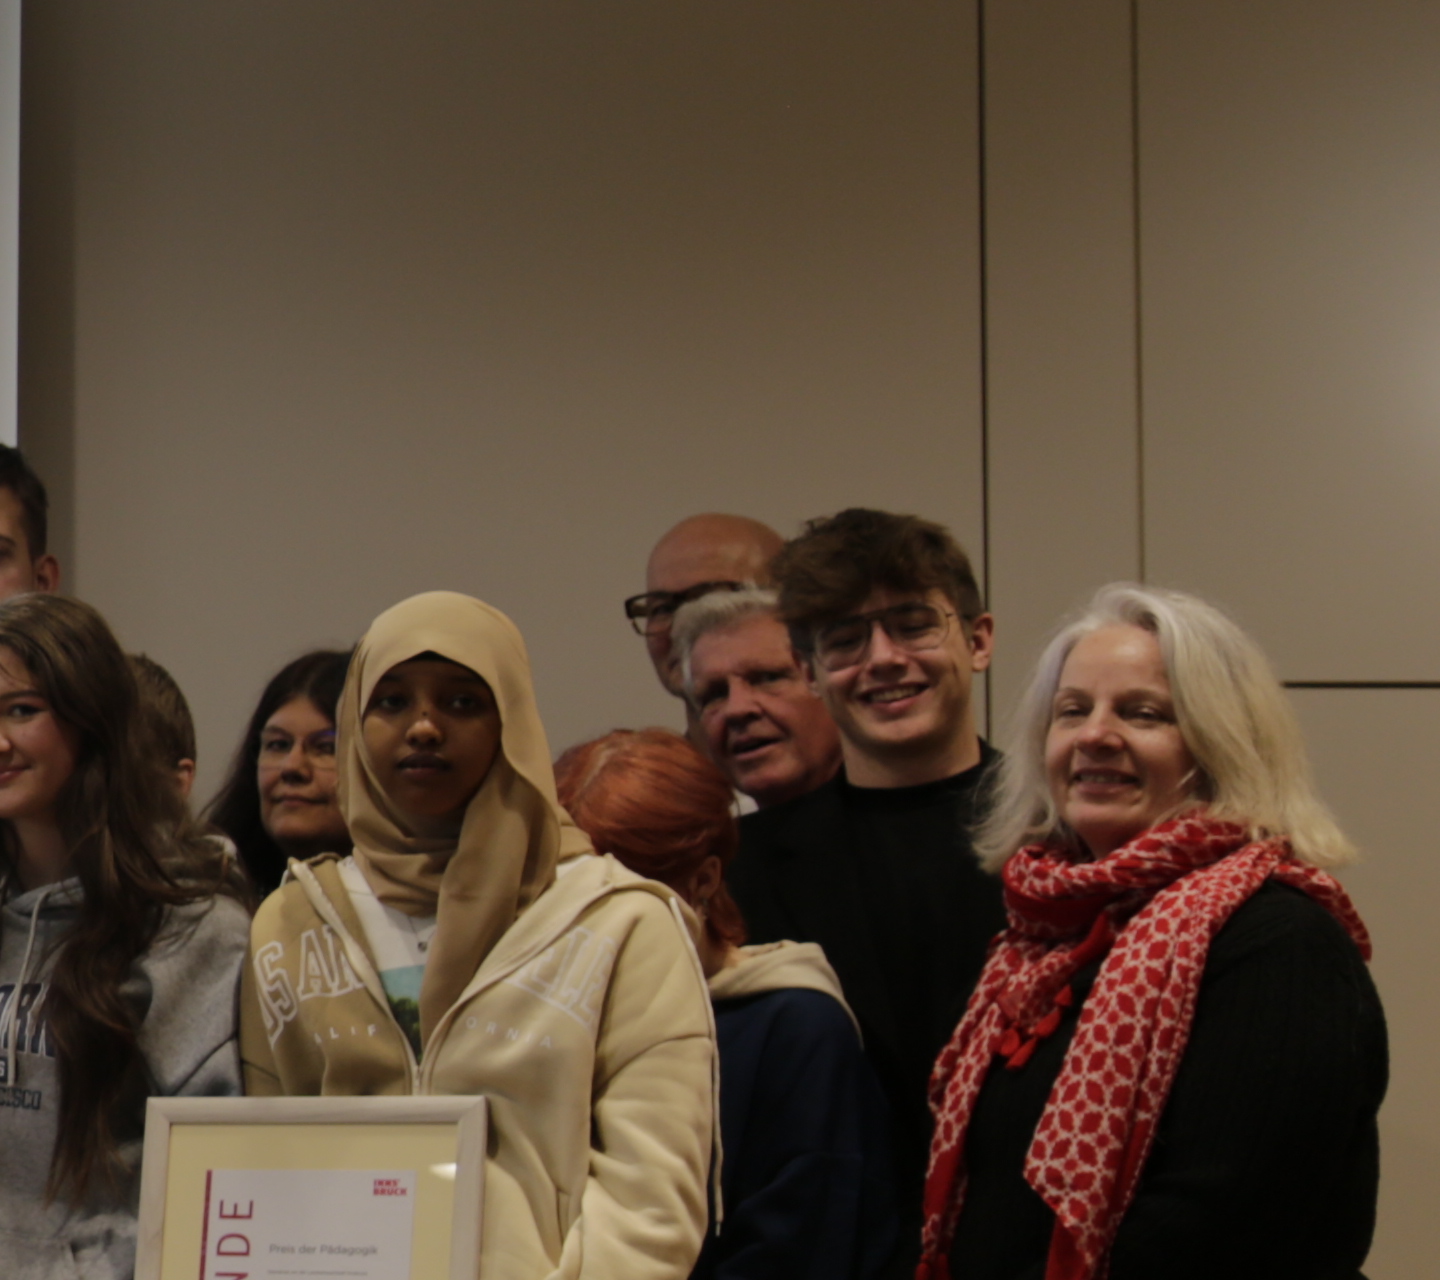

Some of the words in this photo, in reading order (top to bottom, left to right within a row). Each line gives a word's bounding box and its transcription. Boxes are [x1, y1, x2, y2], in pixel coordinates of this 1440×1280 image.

[373, 1187, 408, 1196] BRUCK
[269, 1243, 295, 1255] Preis
[298, 1243, 317, 1255] der
[320, 1243, 378, 1257] Pädagogik
